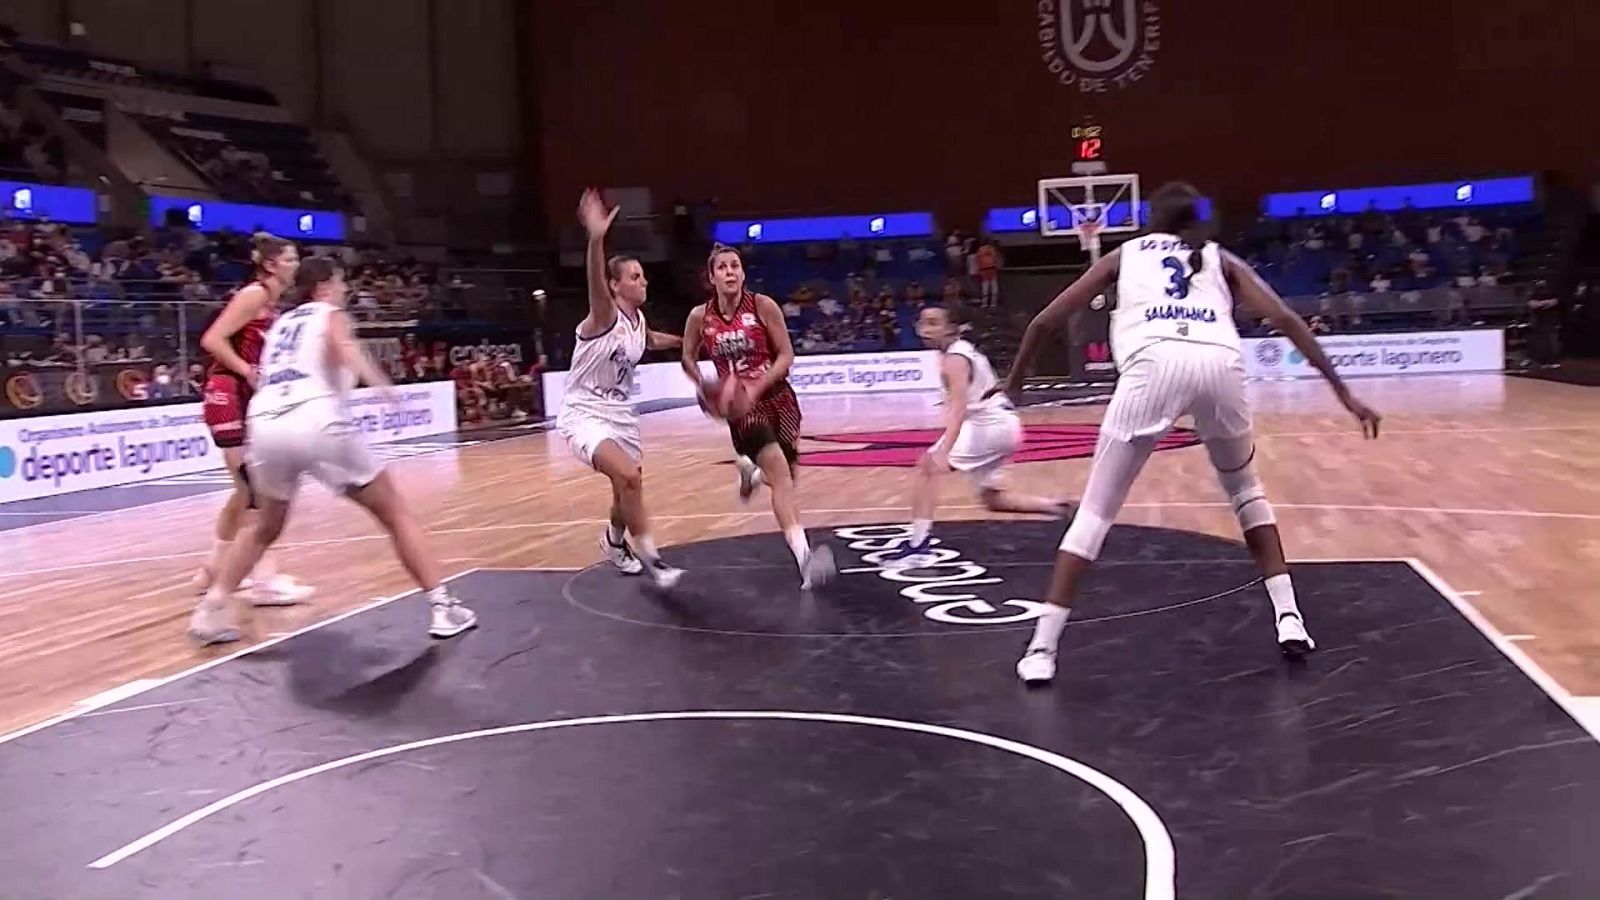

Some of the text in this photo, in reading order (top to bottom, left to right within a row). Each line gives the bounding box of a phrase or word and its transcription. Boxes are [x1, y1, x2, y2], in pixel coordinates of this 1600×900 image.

[1038, 0, 1077, 85] CABILDO
[1079, 77, 1108, 93] DE
[1081, 138, 1101, 158] 12
[1162, 256, 1189, 300] 3
[1145, 305, 1217, 322] SALAMANCA
[1381, 348, 1464, 370] lagunero
[790, 367, 924, 389] eporte lagunero
[21, 435, 209, 488] deporte lagunero
